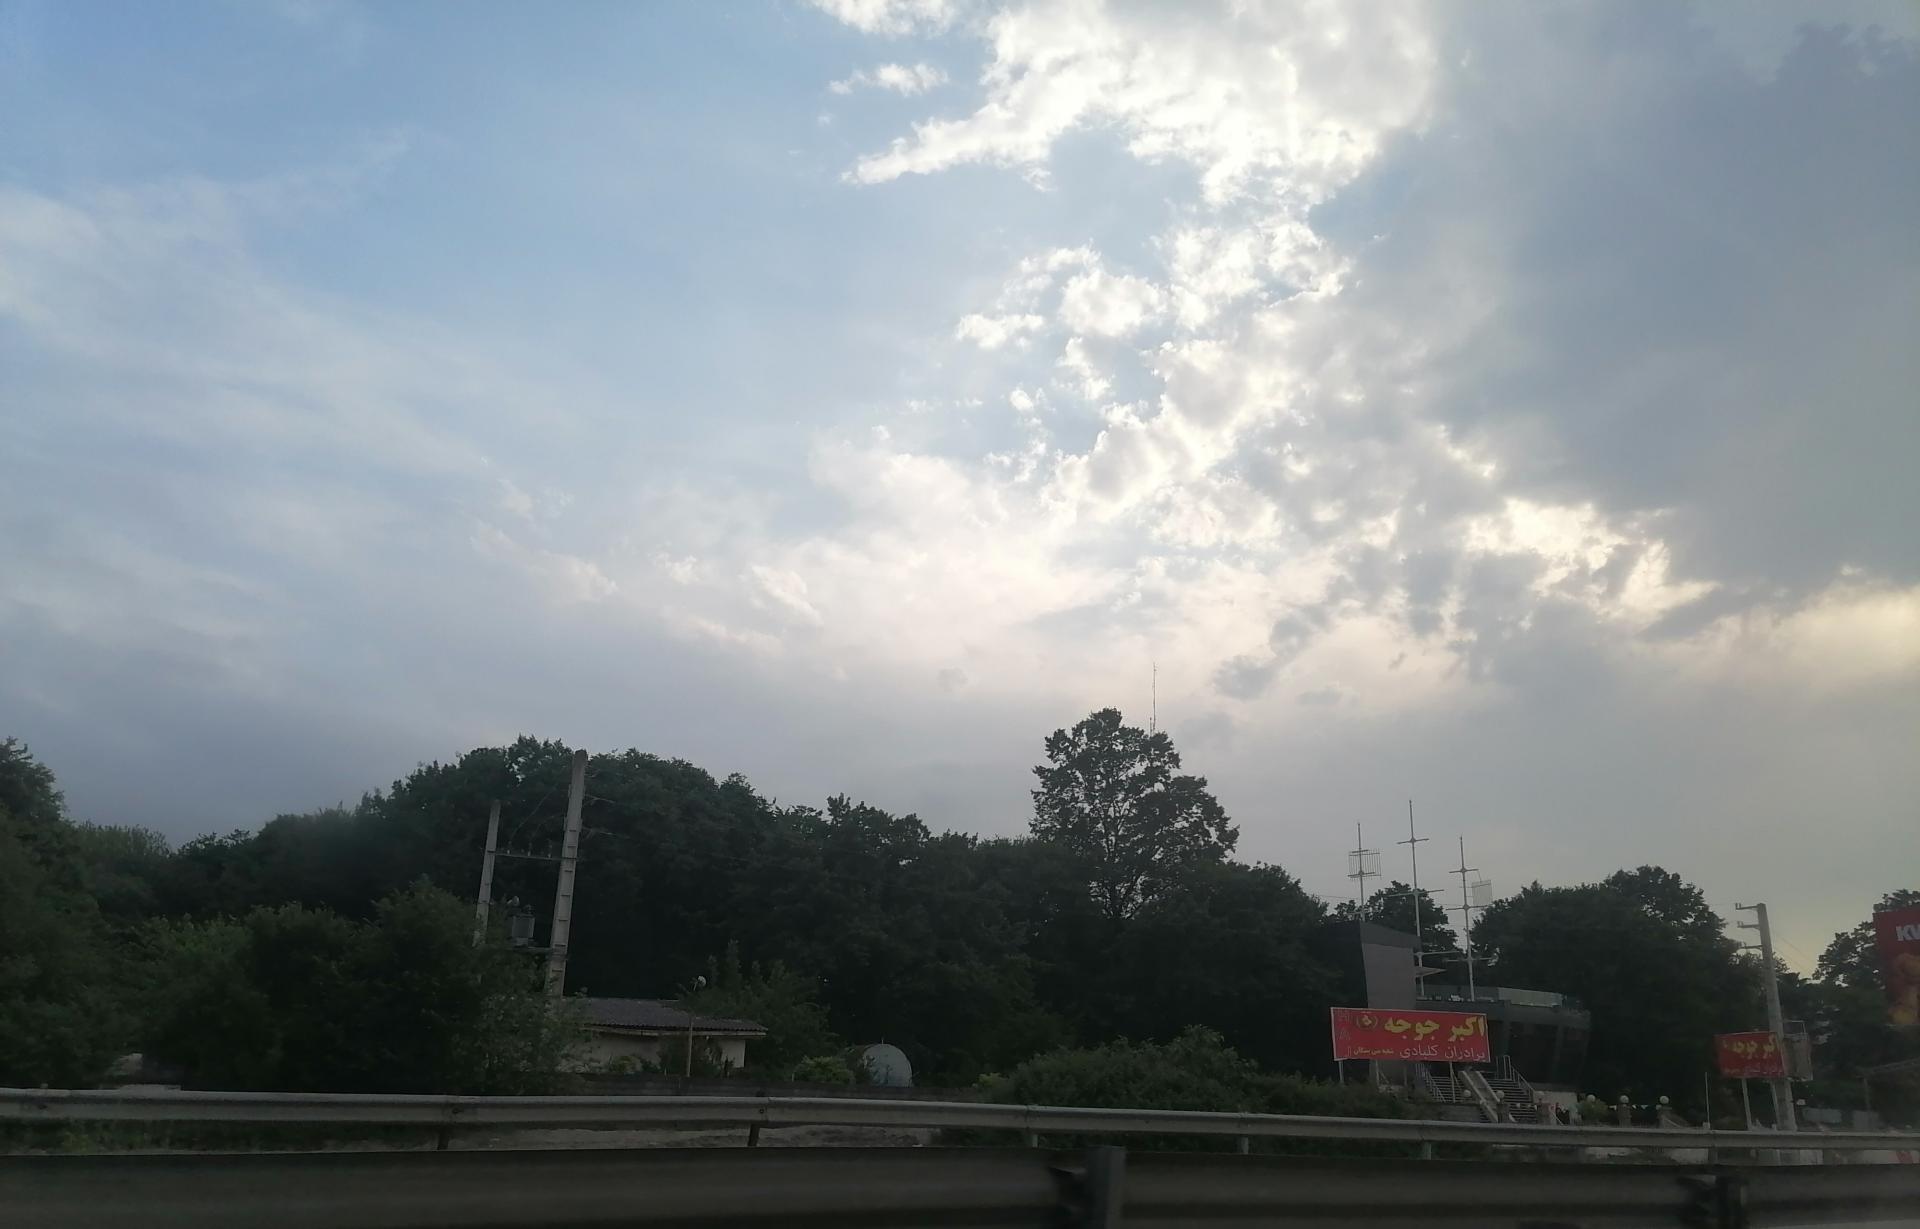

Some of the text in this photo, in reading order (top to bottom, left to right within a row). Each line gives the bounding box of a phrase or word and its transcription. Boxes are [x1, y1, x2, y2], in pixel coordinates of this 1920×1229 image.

[1384, 1015, 1485, 1042] اکبر جوجه
[1444, 1045, 1485, 1061] برادران
